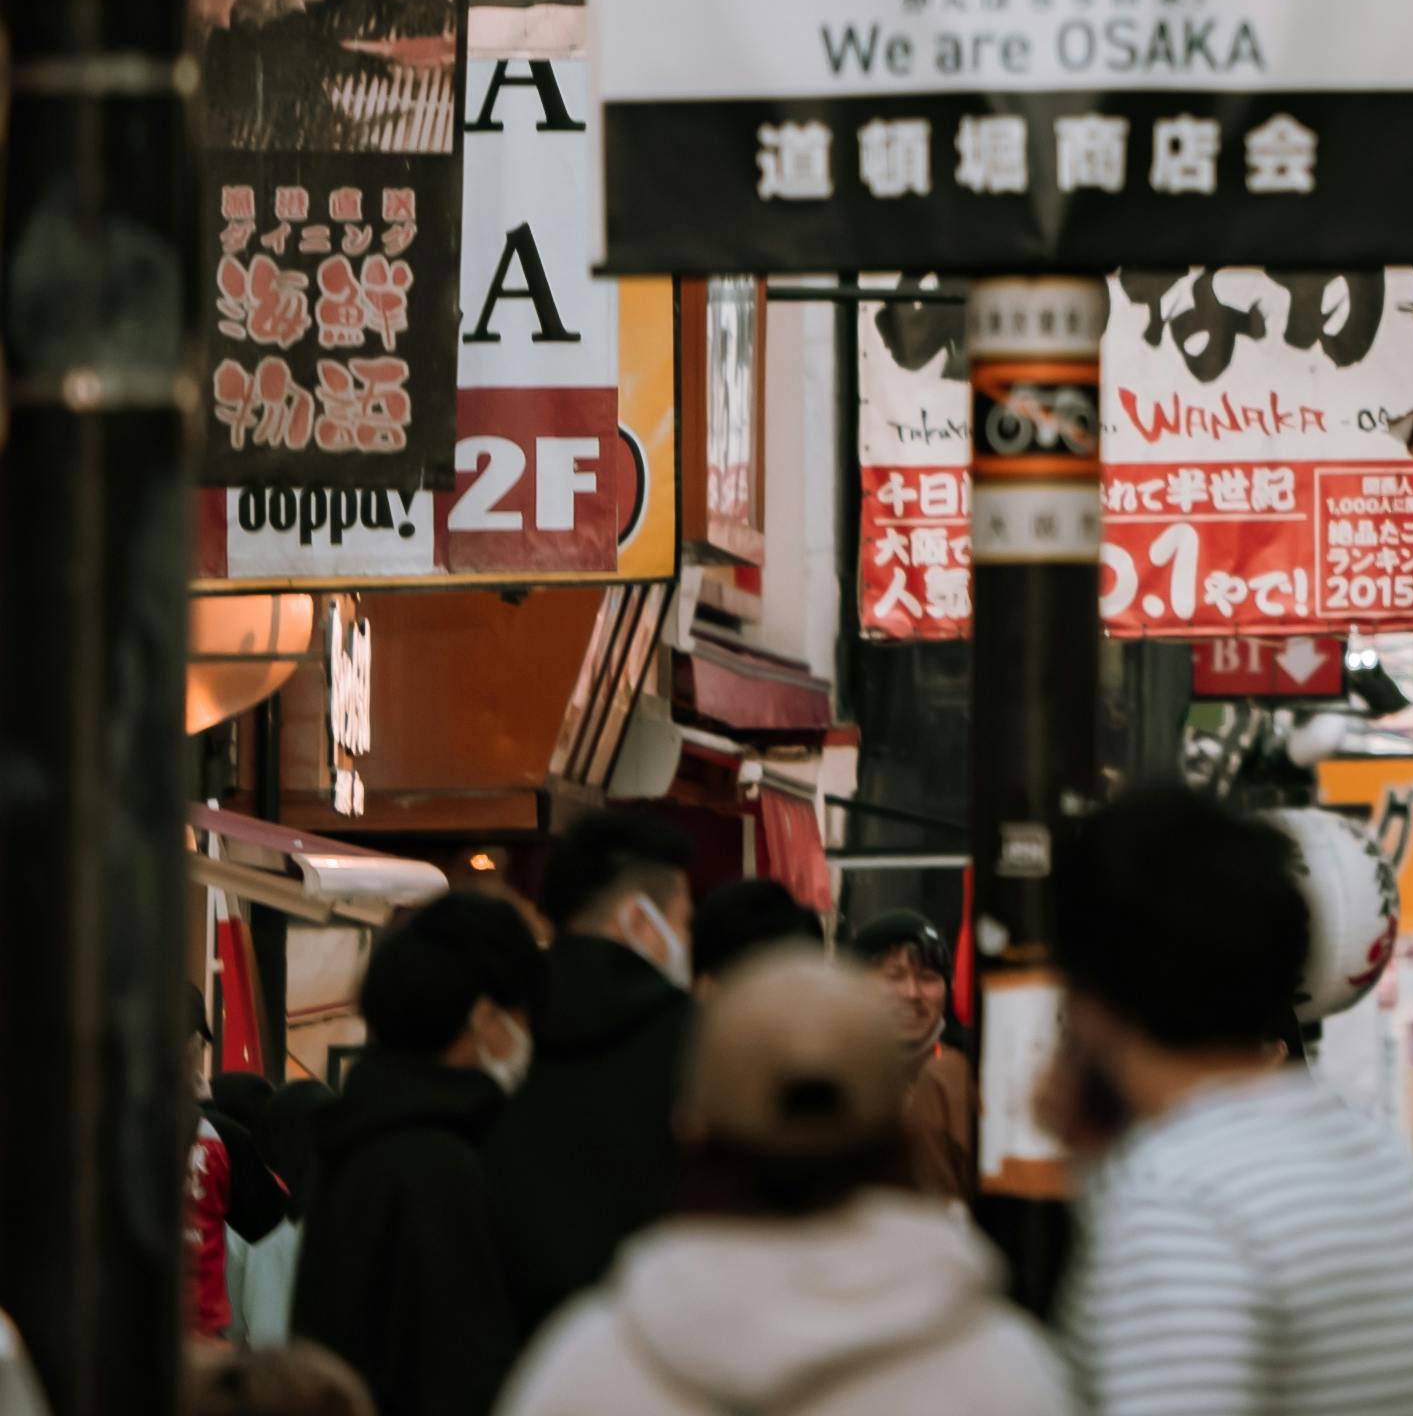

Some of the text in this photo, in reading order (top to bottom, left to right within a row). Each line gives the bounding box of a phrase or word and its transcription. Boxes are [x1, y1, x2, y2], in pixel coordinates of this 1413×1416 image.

[819, 20, 1267, 74] We are OSAKA
[755, 114, 1319, 200] 道頓堀商店会
[448, 436, 601, 533] 2F
